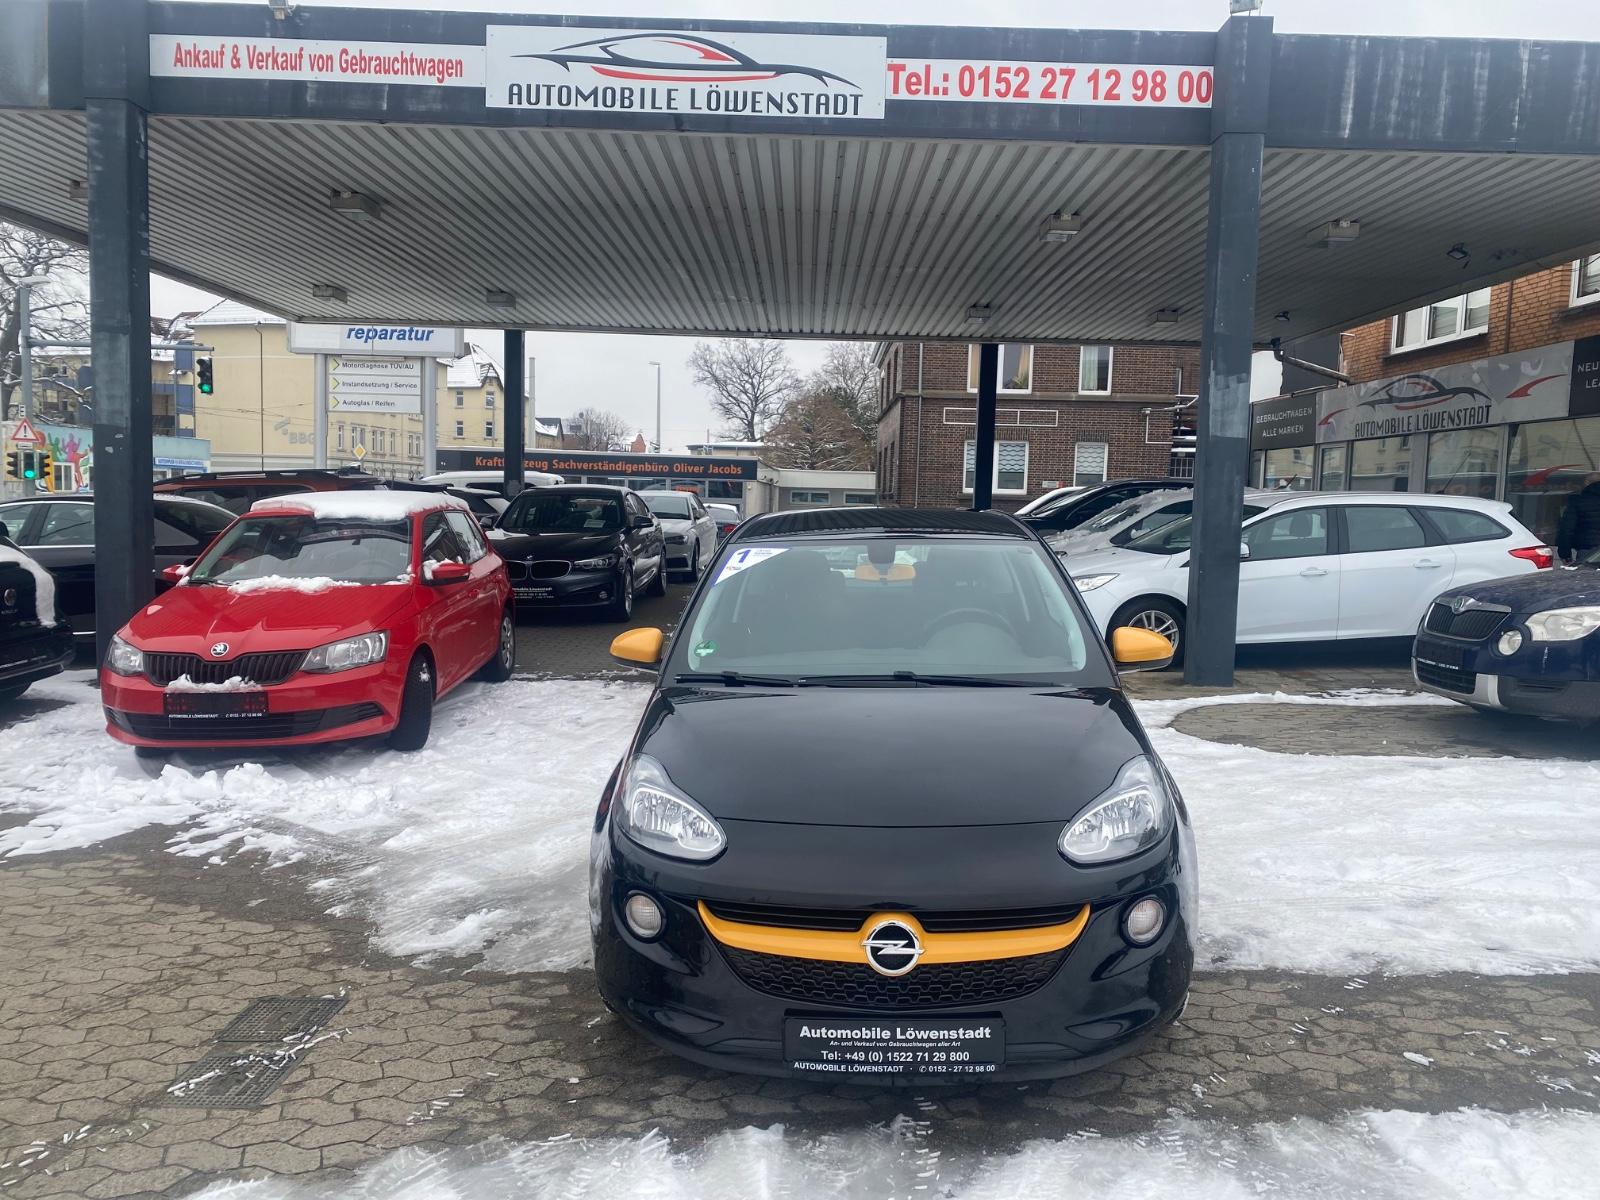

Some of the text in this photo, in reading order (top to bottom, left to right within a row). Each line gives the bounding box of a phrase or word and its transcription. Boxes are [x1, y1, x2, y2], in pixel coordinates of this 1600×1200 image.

[174, 42, 463, 83] Ankauf & Verkauf von Gebrauchtwagen
[887, 64, 1213, 103] Tel.: 0152 27 12 98 00
[508, 83, 863, 116] AUTOMOBILE LÖWENSTADT
[346, 326, 434, 343] reparatur
[342, 362, 388, 370] Motordiagnose
[1256, 408, 1312, 424] GEBRAUCHTWAGEN
[1355, 405, 1492, 438] AUTOMOBILE LÖWENSTADT
[1262, 428, 1277, 438] ALLE
[552, 459, 669, 473] Sachverständigenbüro
[674, 463, 704, 473] Oliver
[708, 464, 742, 474] Jacobs
[800, 1026, 991, 1039] Automobile Löwenstadt
[821, 1051, 969, 1062] Tel: +49 (0) 1522 71 29 800
[794, 1062, 846, 1072] AUTOMOBILE
[849, 1064, 903, 1072] LÖWENSTADT
